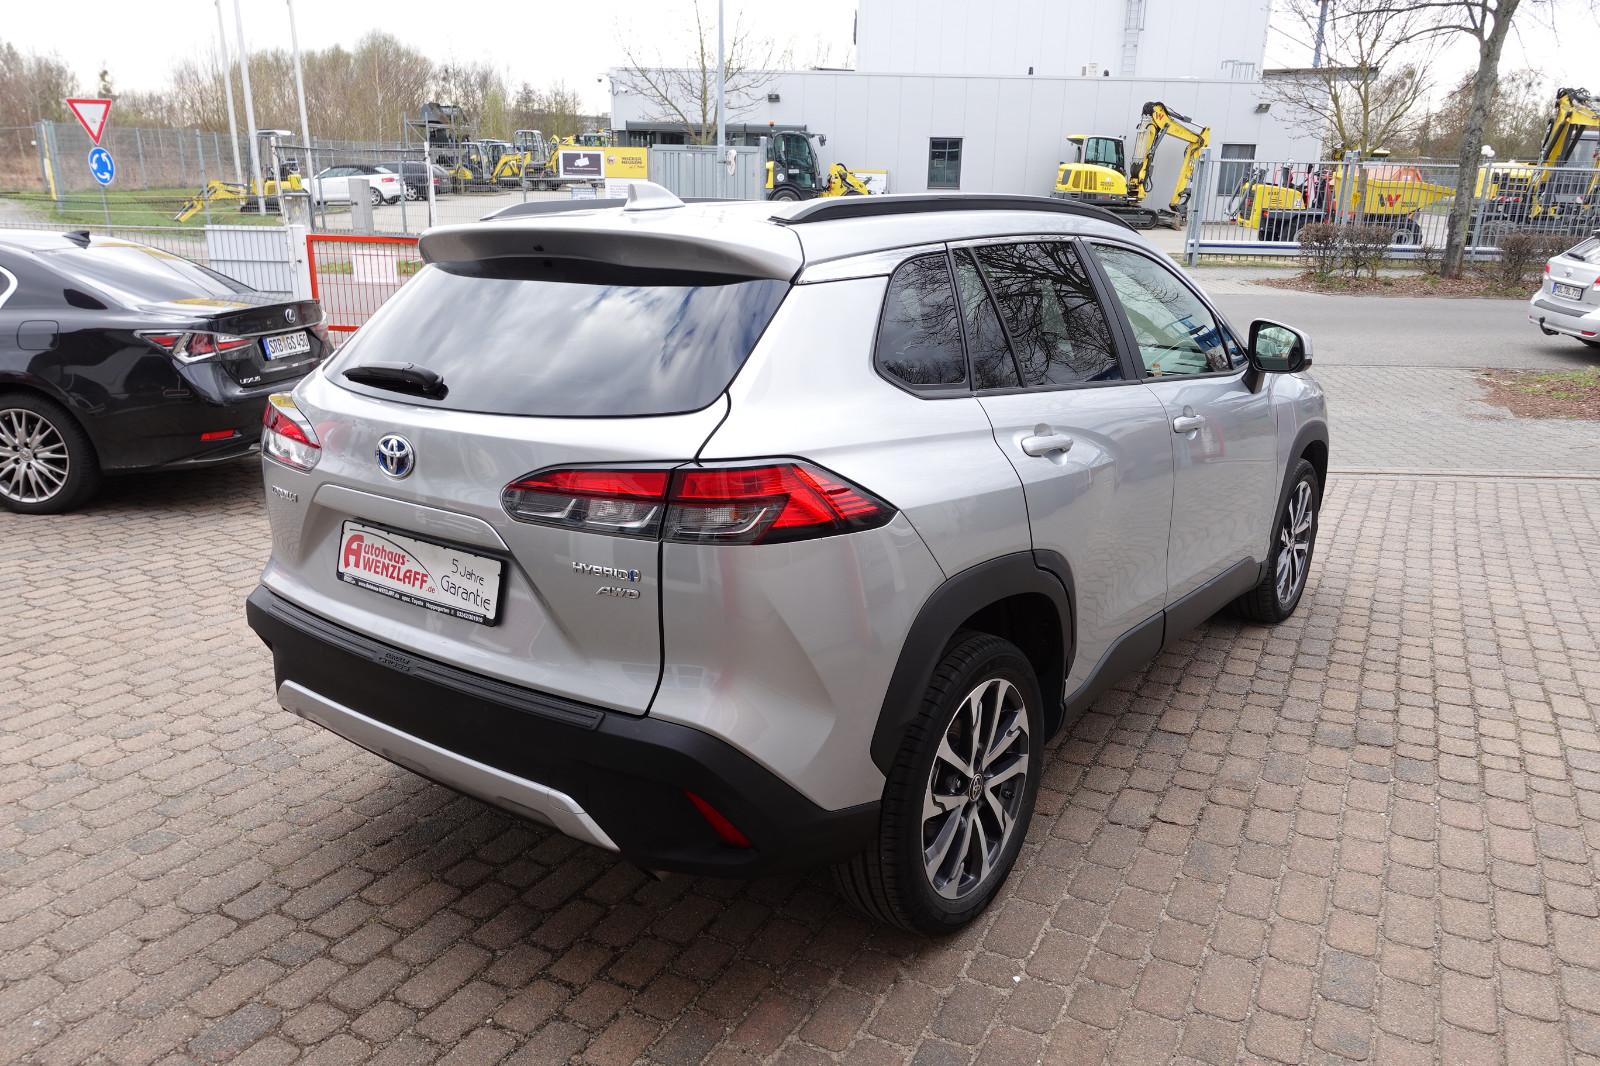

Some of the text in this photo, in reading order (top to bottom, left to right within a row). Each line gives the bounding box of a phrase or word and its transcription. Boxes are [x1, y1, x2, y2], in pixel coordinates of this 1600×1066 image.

[268, 338, 284, 354] SRB
[451, 558, 484, 586] 5 Jahre
[572, 561, 629, 580] HYBRID
[440, 574, 491, 611] Garantie
[595, 586, 640, 599] AWD
